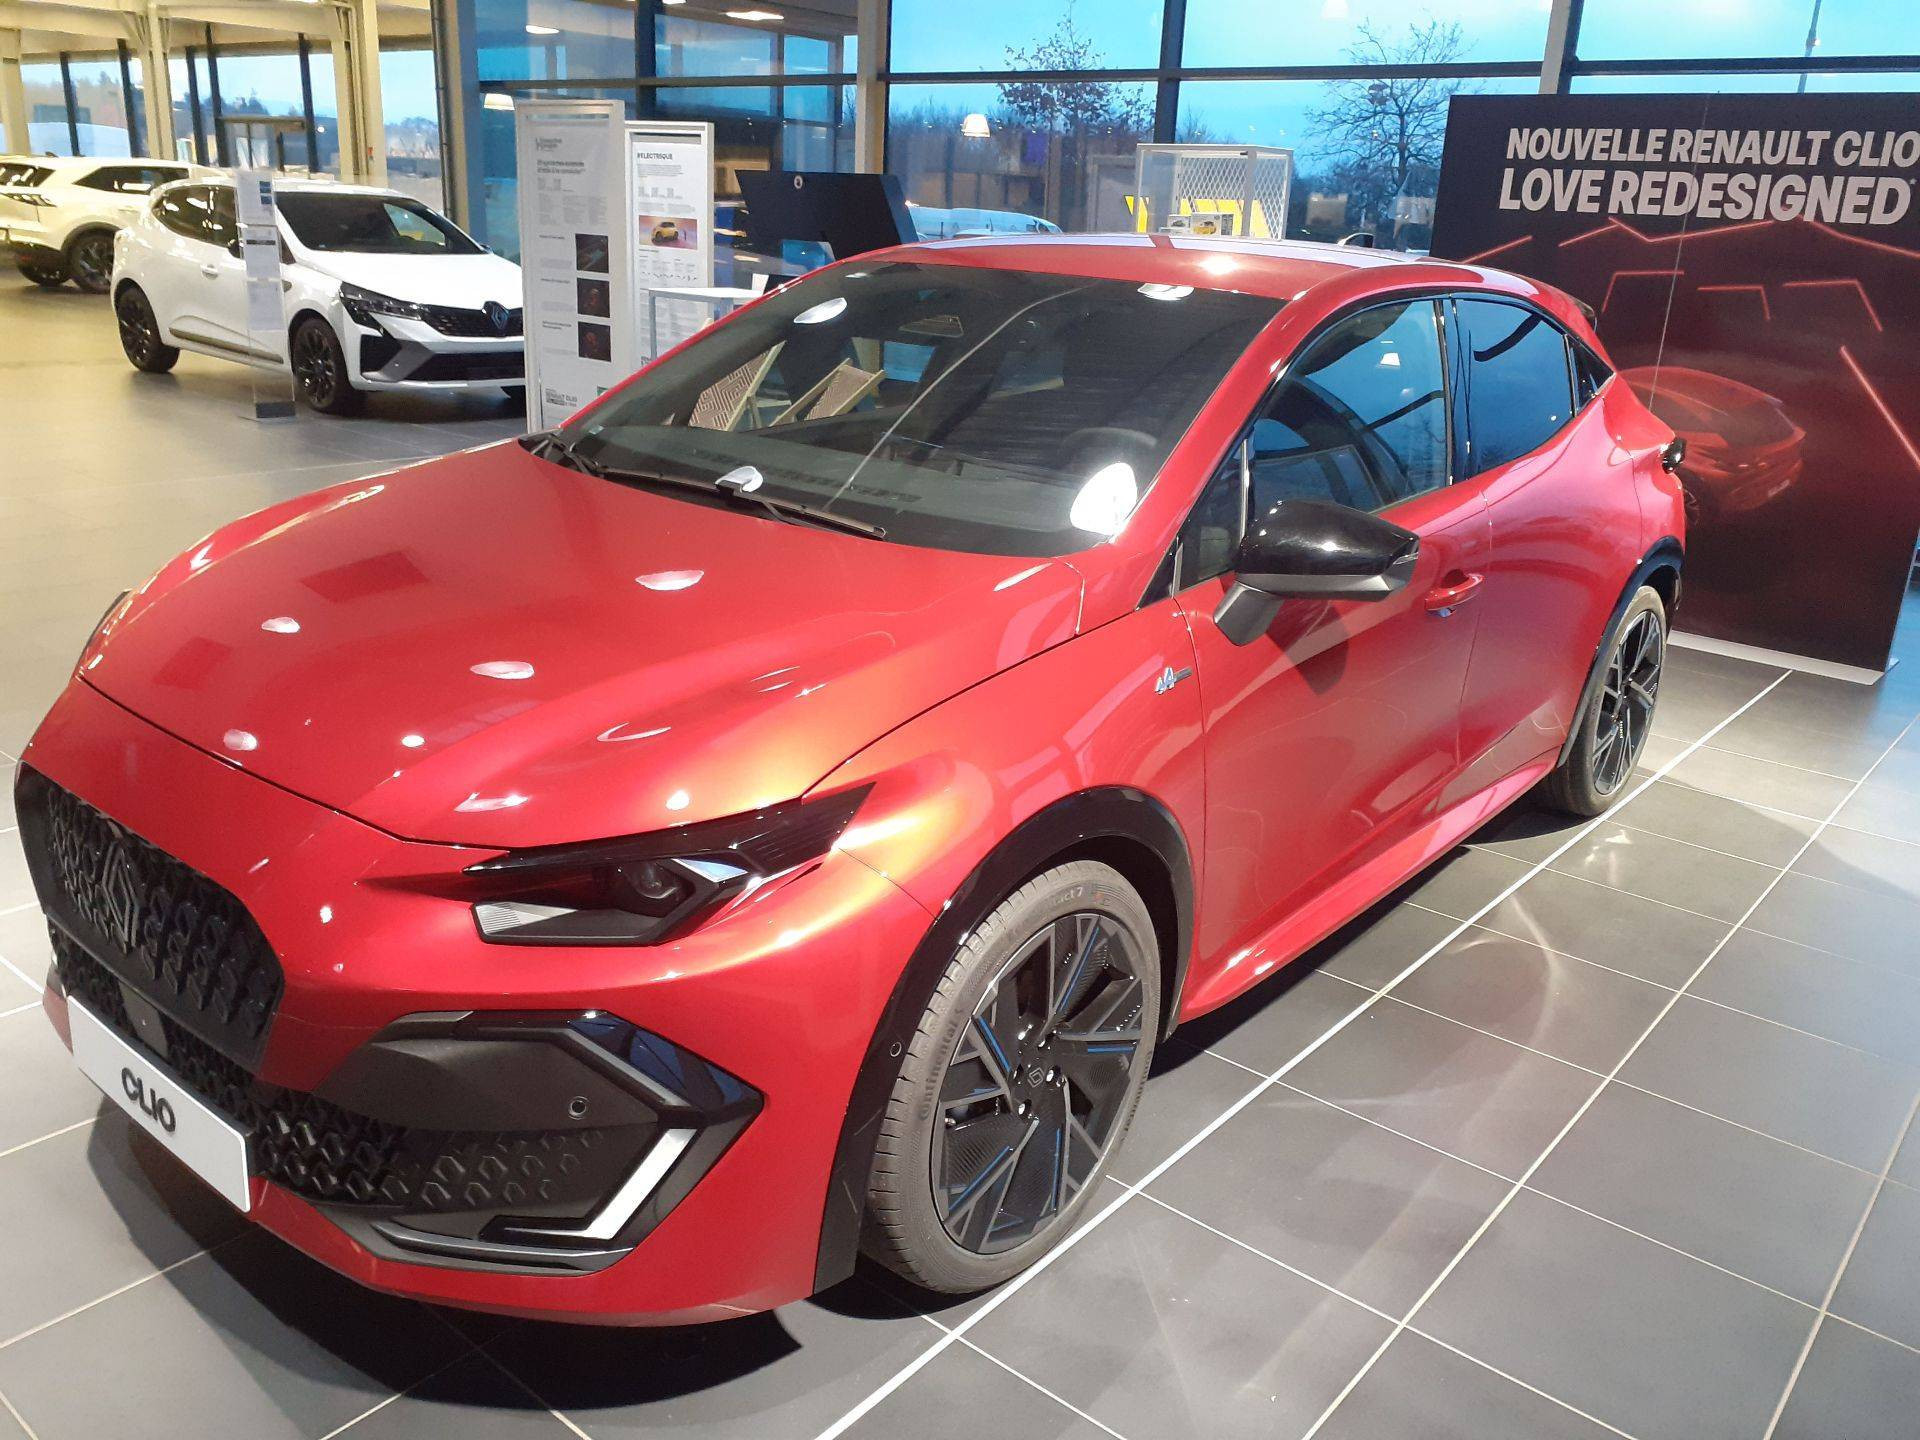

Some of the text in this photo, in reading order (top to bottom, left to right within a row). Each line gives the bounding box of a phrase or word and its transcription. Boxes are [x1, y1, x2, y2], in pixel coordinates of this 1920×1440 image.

[1506, 127, 1920, 168] NOUVELLE RENAULT CLIO
[1499, 168, 1607, 214] LOVE
[920, 1019, 958, 1121] Continental
[121, 1066, 177, 1132] CLIO
